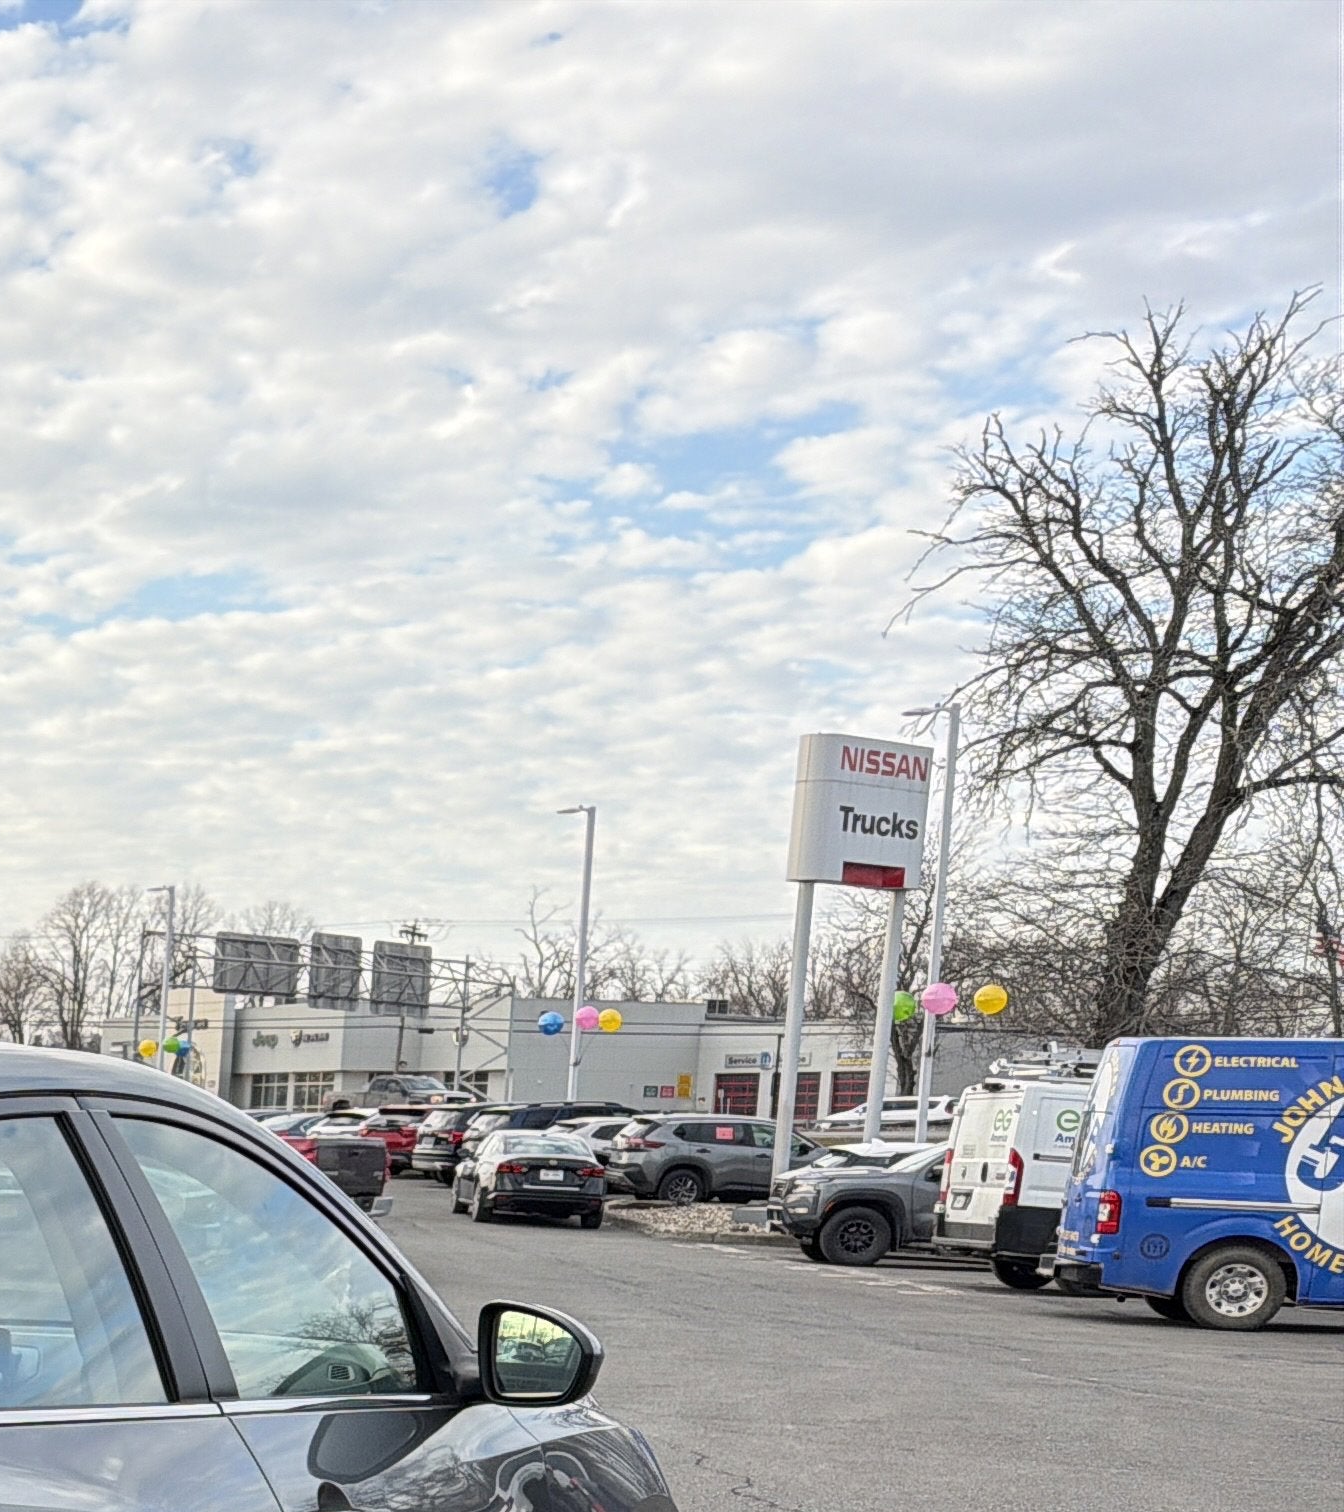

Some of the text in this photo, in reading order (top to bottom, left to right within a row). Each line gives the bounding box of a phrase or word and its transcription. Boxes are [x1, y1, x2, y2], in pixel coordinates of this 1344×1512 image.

[840, 745, 929, 782] NISSAN
[839, 805, 919, 840] Trucks
[728, 1056, 758, 1065] Service
[1214, 1056, 1299, 1069] ELECTRICAL
[1203, 1089, 1280, 1102] PLUMBING
[1192, 1121, 1255, 1136] HEATING
[1180, 1155, 1208, 1169] A/C
